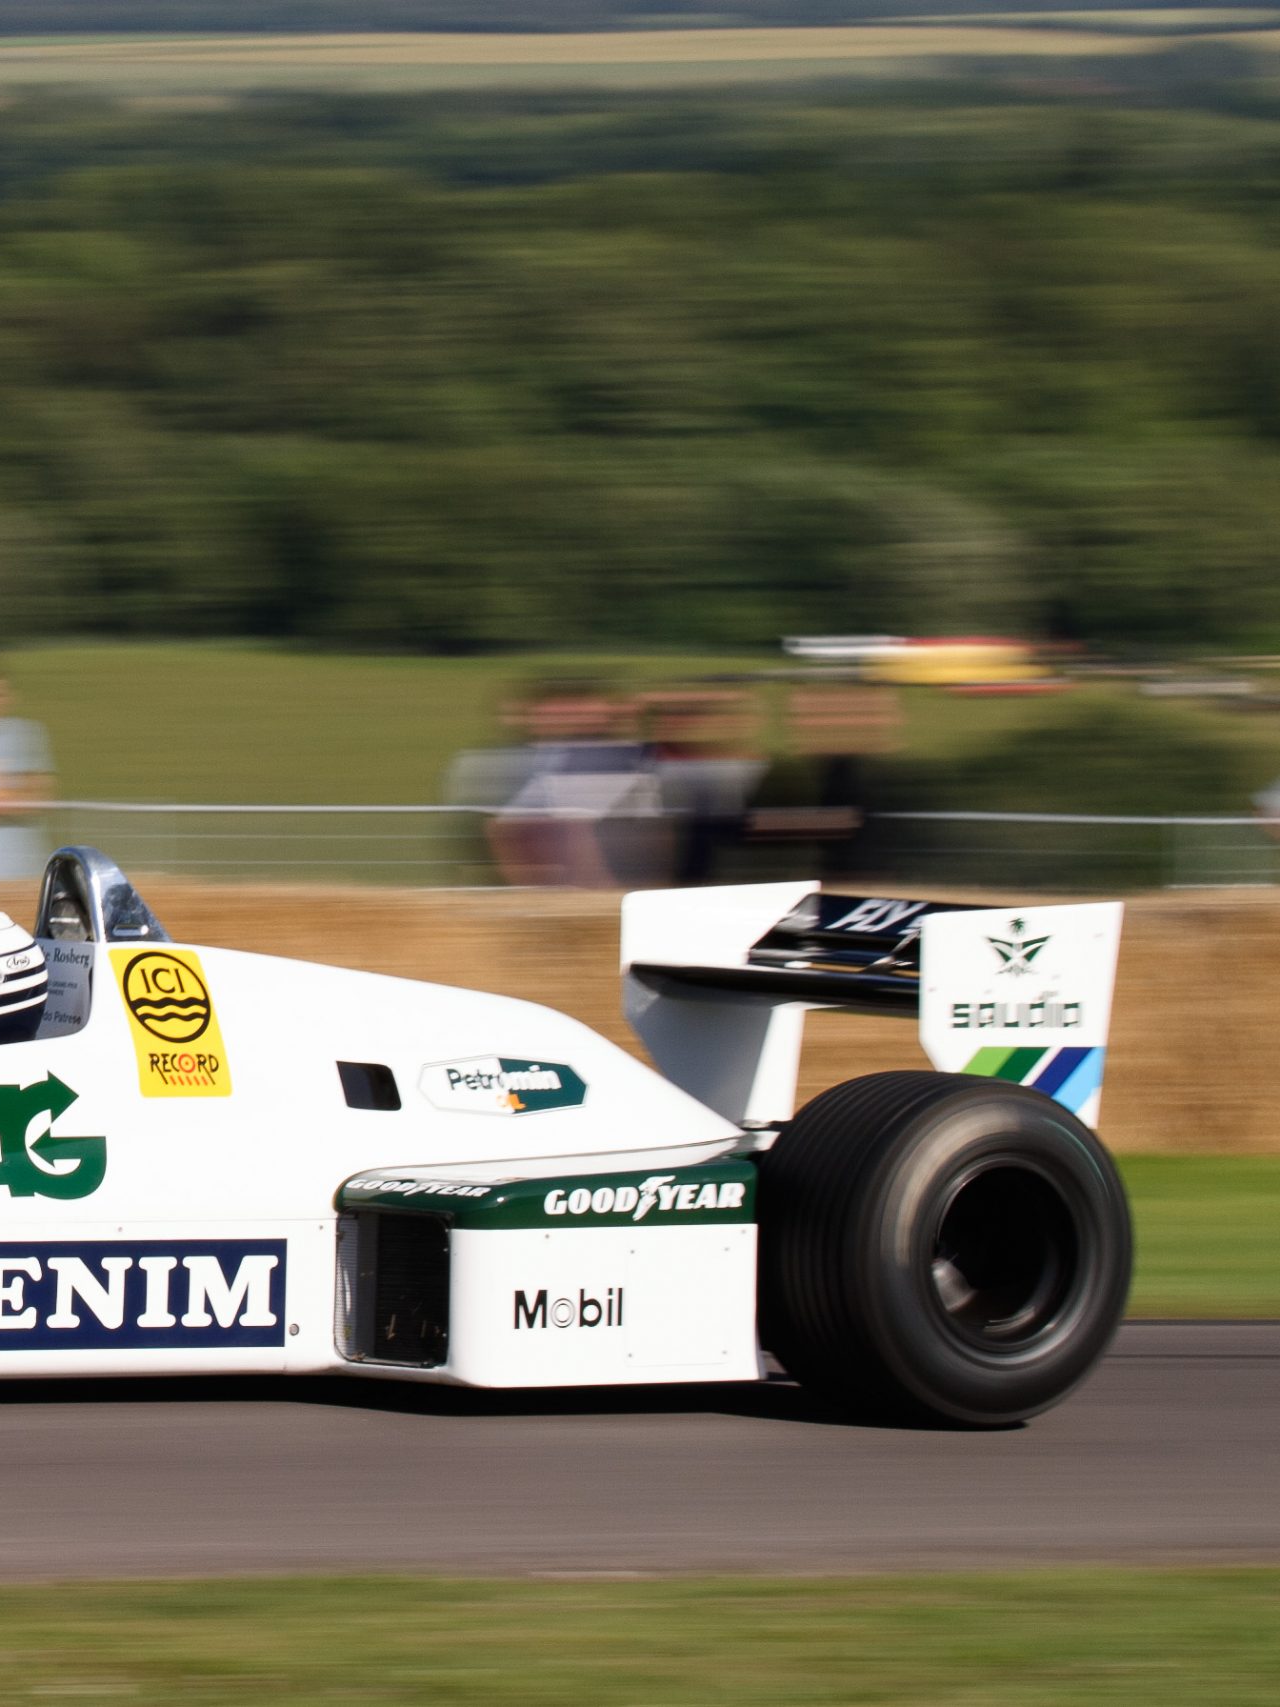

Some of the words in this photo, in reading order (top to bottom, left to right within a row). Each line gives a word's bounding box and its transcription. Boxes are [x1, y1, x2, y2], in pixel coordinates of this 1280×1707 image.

[53, 947, 90, 969] Rosberg
[139, 967, 185, 995] ICI
[149, 1053, 219, 1085] RECORD
[446, 1065, 562, 1092] Petromin
[513, 1287, 624, 1330] Mobil
